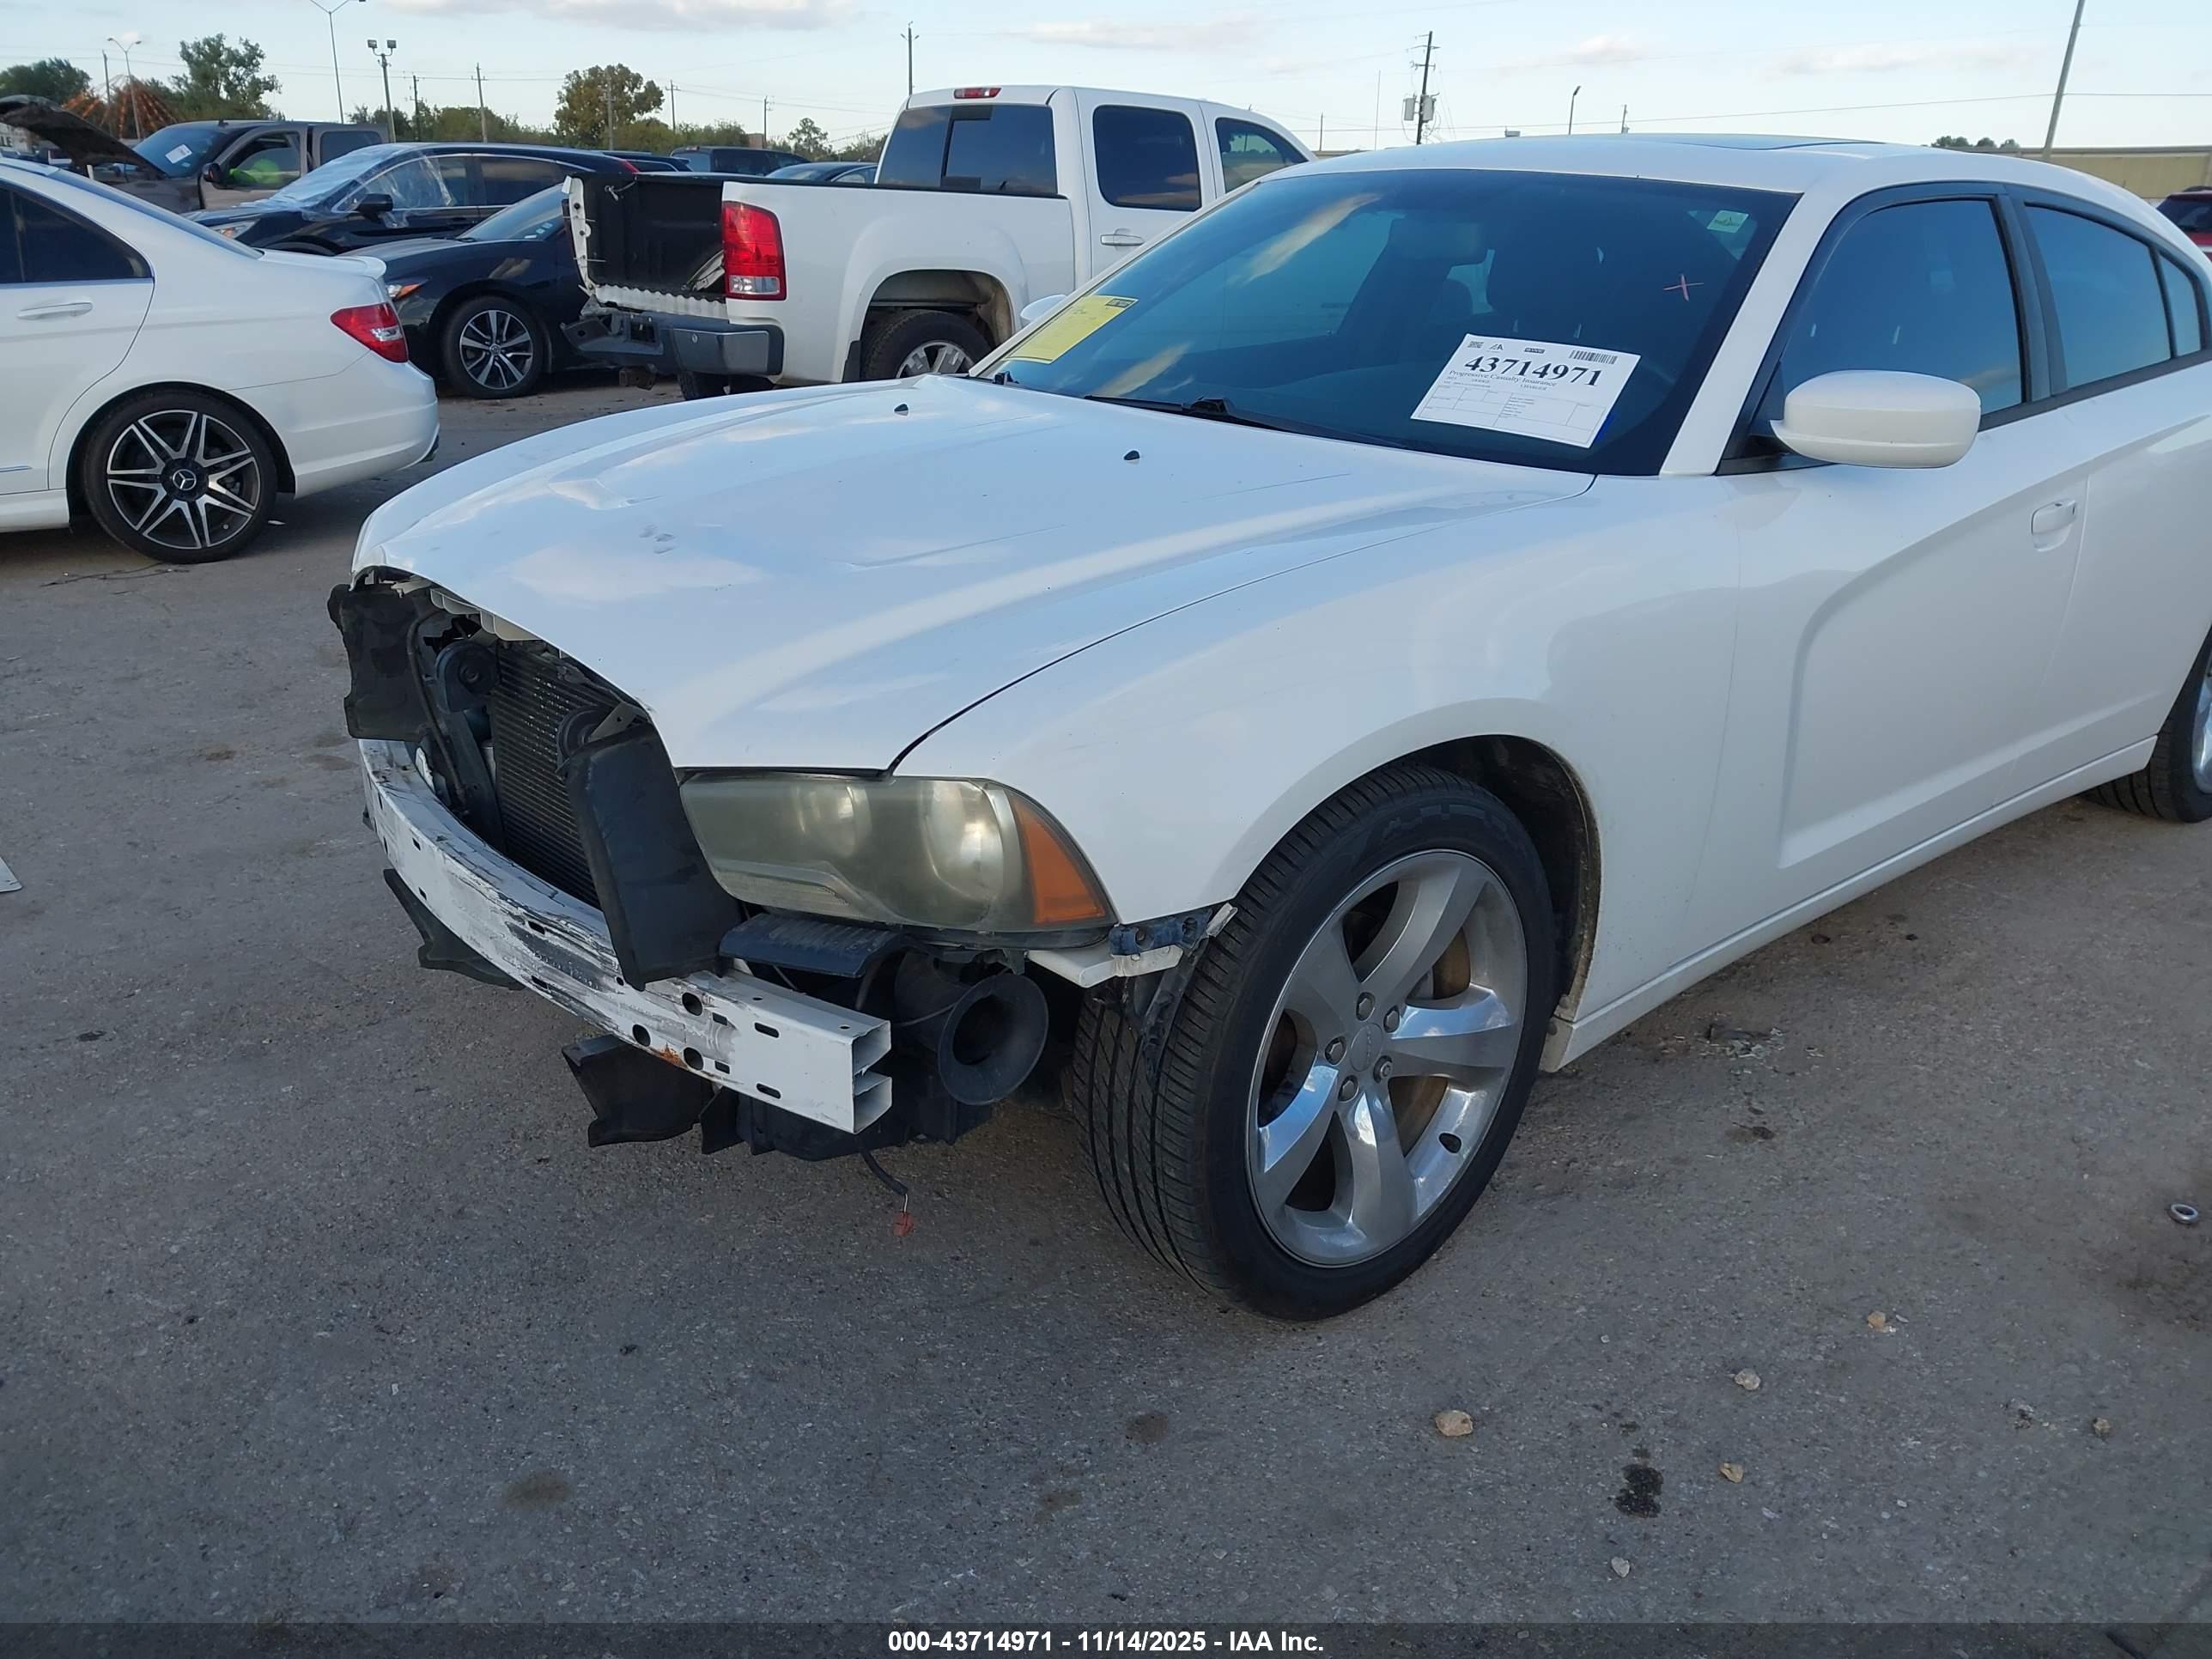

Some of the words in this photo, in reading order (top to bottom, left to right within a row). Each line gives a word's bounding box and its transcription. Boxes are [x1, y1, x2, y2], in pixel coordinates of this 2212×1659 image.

[1449, 370, 1490, 380] Progressive
[1491, 374, 1520, 383] Casualty
[1522, 378, 1558, 386] Insurance
[1464, 356, 1603, 386] 43714971
